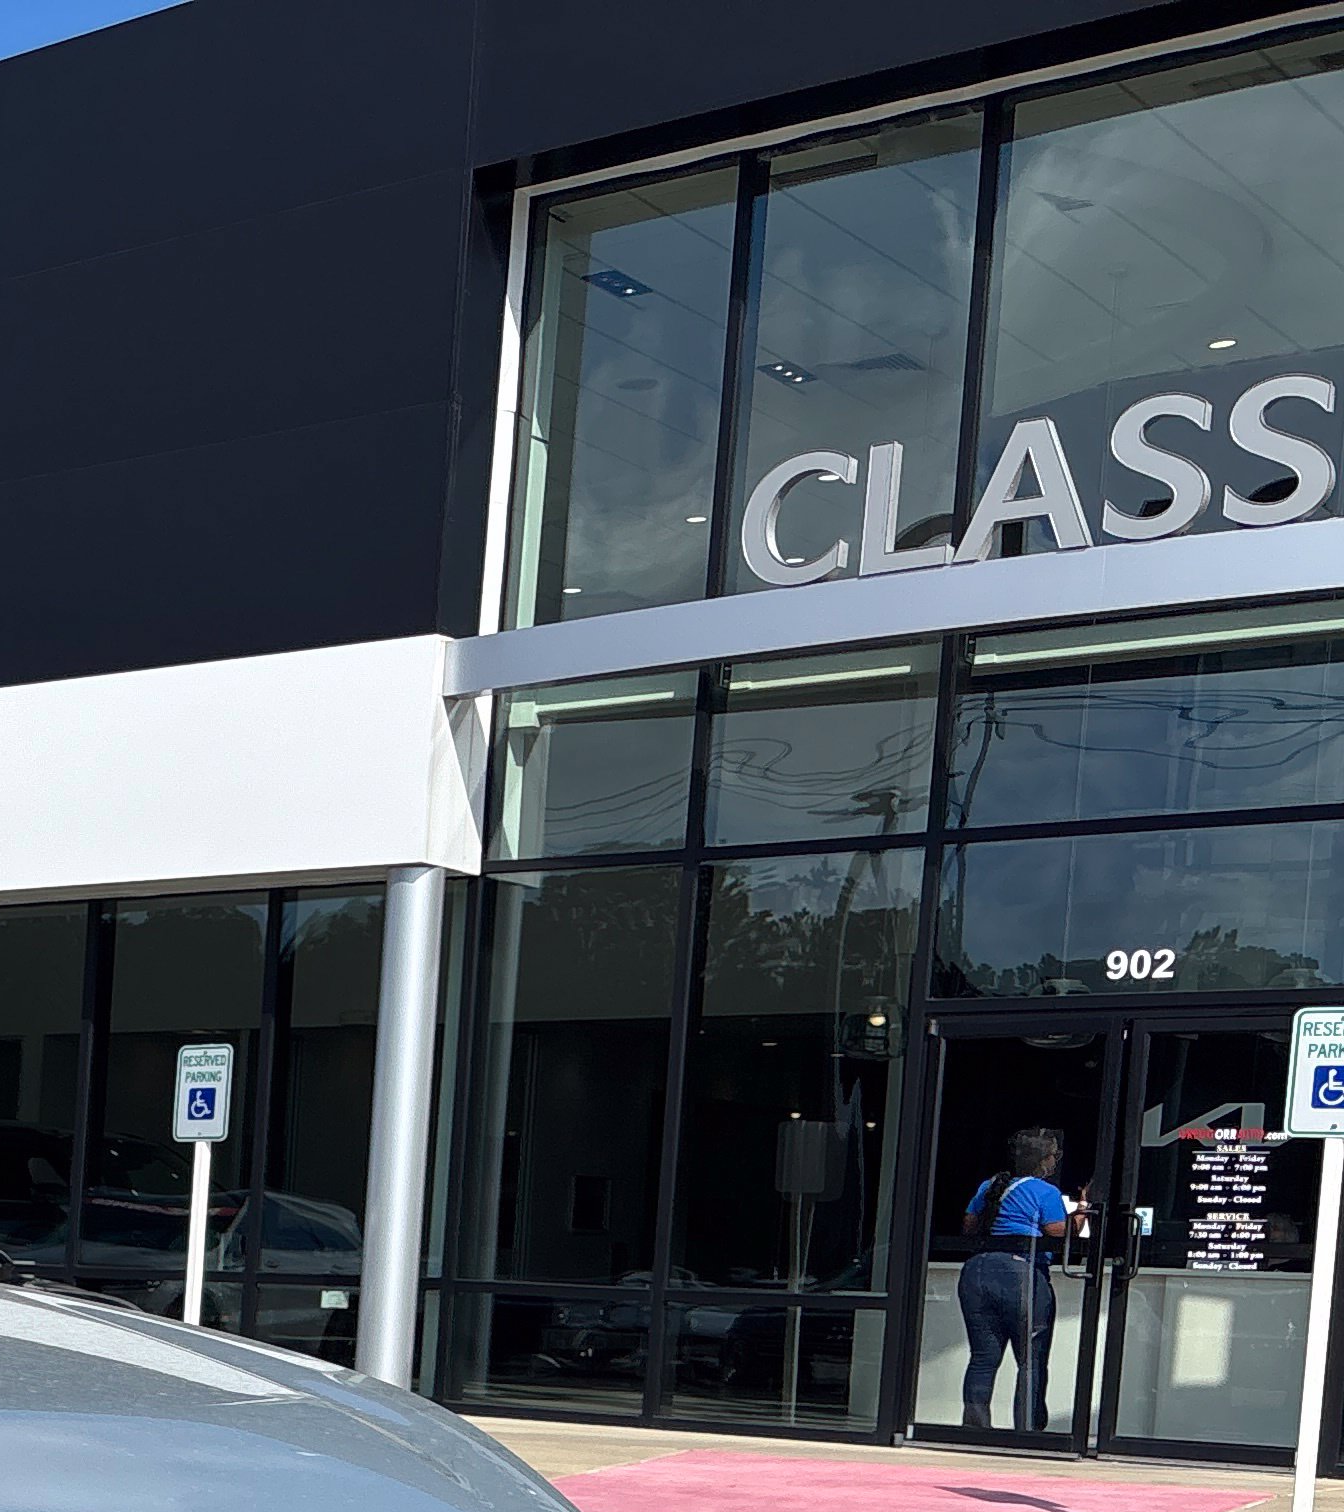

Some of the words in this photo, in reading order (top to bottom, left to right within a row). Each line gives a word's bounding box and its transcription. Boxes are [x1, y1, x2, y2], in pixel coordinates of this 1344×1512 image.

[742, 372, 1336, 587] CLASS
[1106, 949, 1176, 980] 902
[1303, 1022, 1344, 1036] RESE
[183, 1055, 226, 1066] RESERVED
[185, 1071, 222, 1083] PARKING
[1196, 1155, 1229, 1164] Monday
[1239, 1155, 1266, 1163] Friday
[1211, 1175, 1249, 1183] Saturday
[1197, 1196, 1227, 1205] Sunday
[1193, 1223, 1226, 1231] Monday
[1235, 1223, 1263, 1231] Friday
[1208, 1243, 1247, 1251] Saturday
[1193, 1262, 1222, 1272] Sunday
